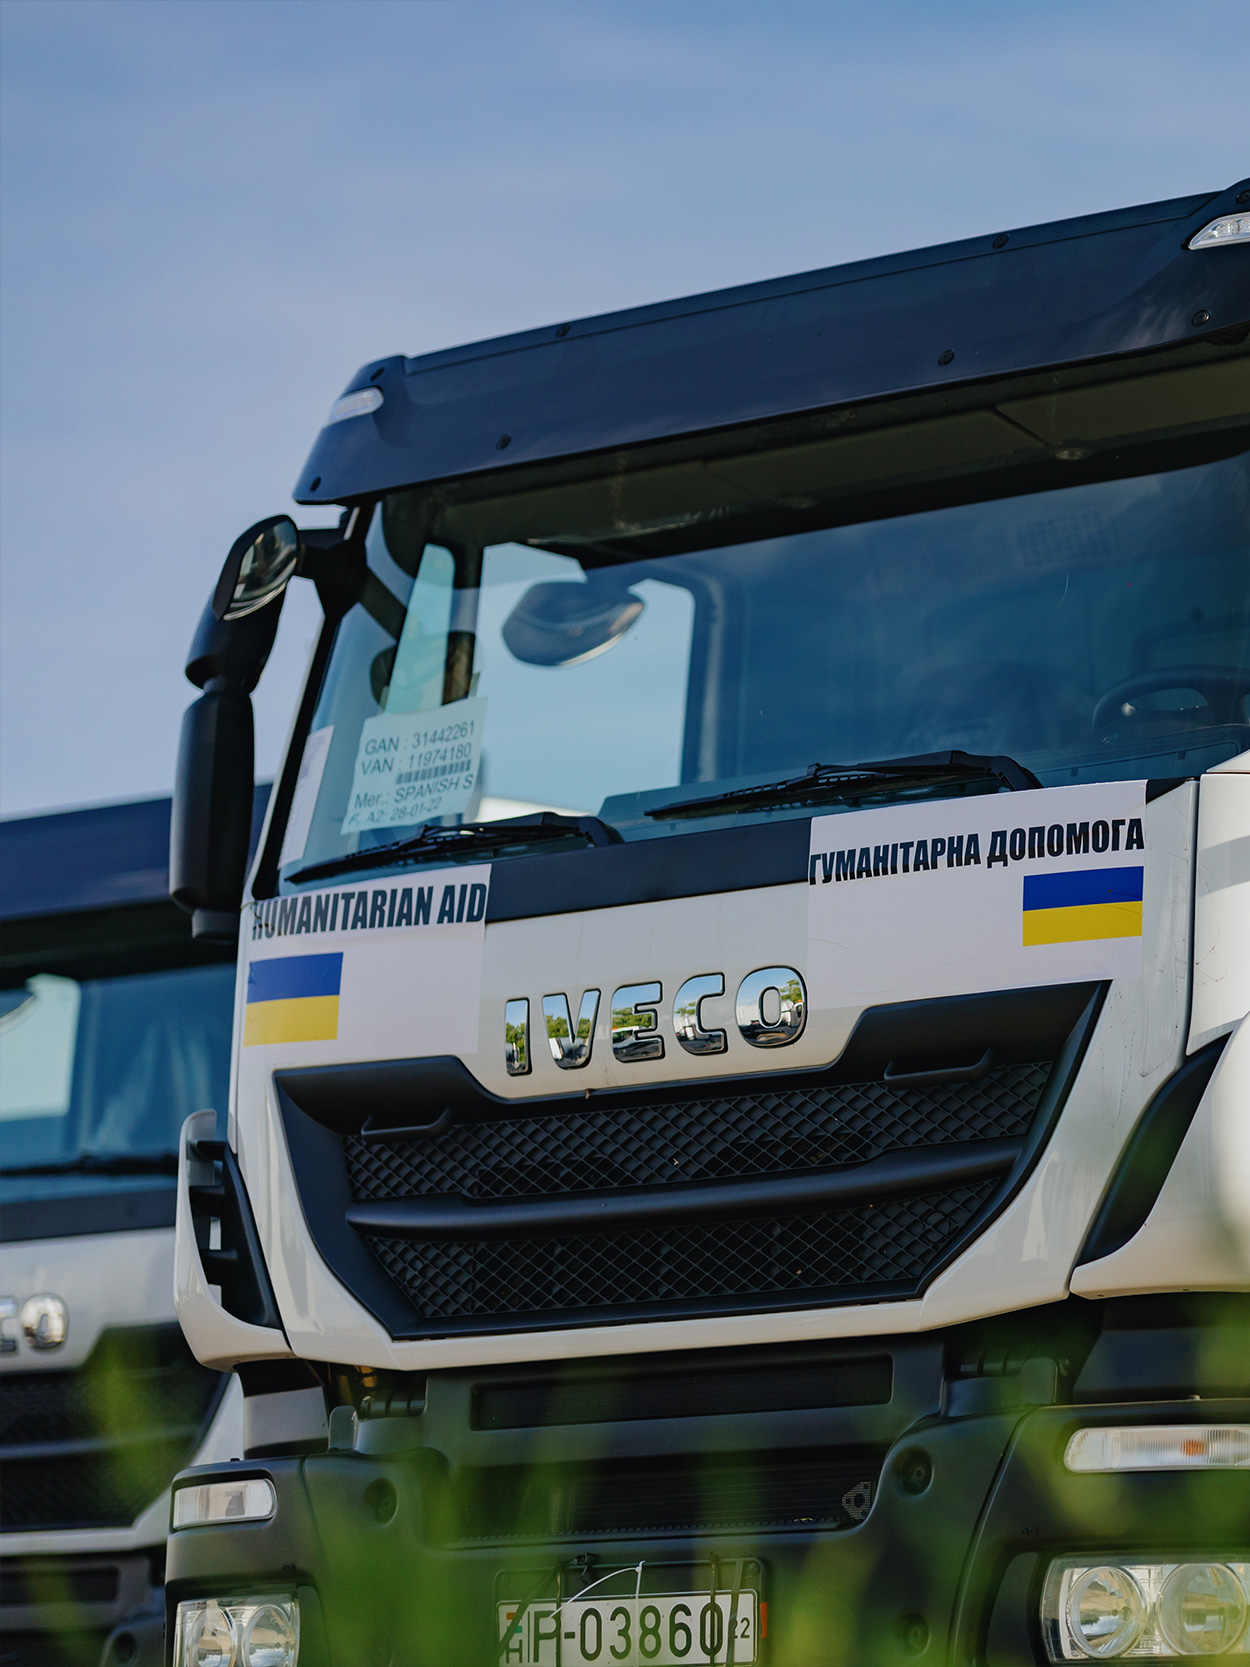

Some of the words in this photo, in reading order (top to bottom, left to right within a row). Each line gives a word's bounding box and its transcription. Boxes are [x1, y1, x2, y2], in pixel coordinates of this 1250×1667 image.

[361, 757, 394, 775] VAN
[409, 741, 473, 769] 11974180
[365, 736, 400, 756] GAN
[412, 720, 475, 749] 31442261
[394, 776, 460, 804] SPANISH
[808, 832, 982, 885] ГУМАНІТАРНА
[986, 818, 1145, 869] ДОПОМОГА
[252, 886, 434, 941] HUMANITARIAN
[436, 883, 488, 925] AID
[504, 965, 808, 1077] IVECO
